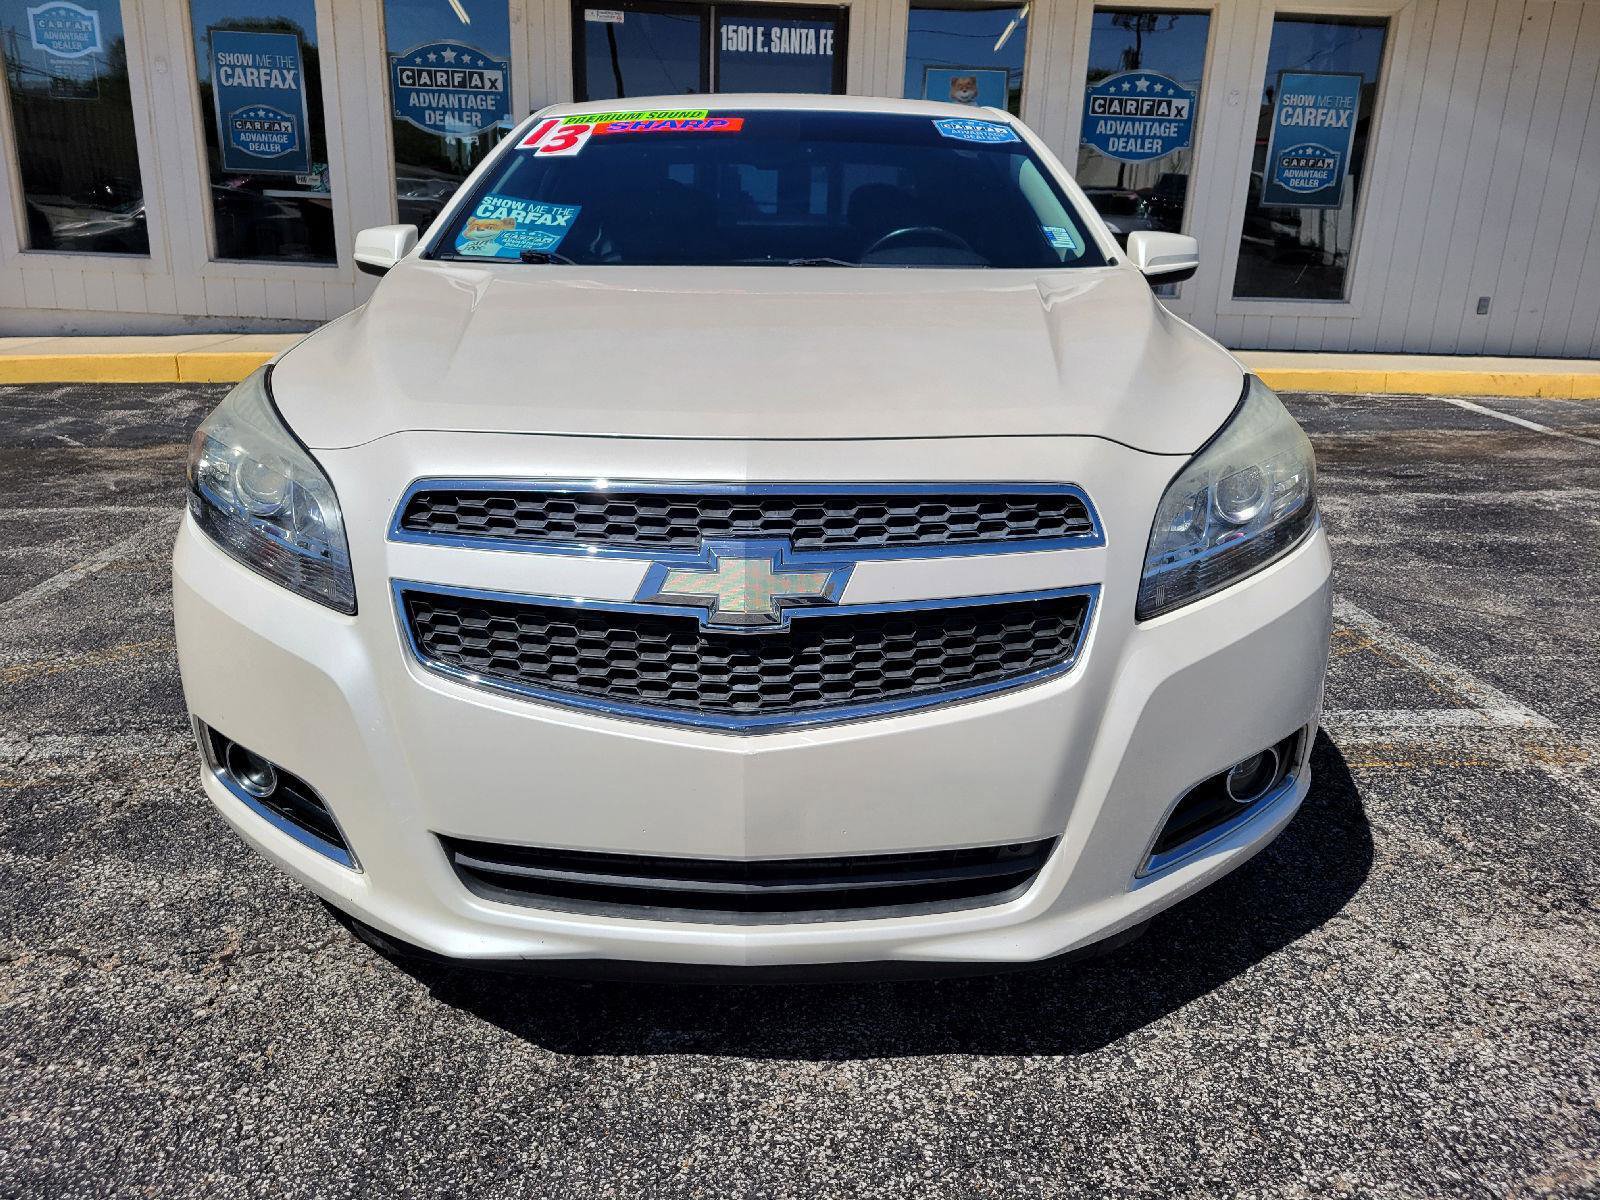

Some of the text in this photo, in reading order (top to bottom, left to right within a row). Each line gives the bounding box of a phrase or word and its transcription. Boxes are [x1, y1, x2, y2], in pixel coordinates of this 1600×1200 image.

[39, 20, 92, 32] CARFAX
[44, 31, 89, 41] ADVANTAGE
[720, 25, 834, 56] 1501 E. SANTA FE
[53, 40, 82, 49] DEALER
[217, 52, 296, 69] SHOW ME THE
[219, 66, 298, 90] CARFAX
[401, 70, 499, 91] CARFAX
[409, 92, 496, 110] ADVANTAGE
[1093, 98, 1186, 118] CARFAX
[1282, 94, 1353, 109] SHOW ME THE
[424, 110, 482, 126] DEALER
[566, 110, 702, 125] PREMIUM SOUND
[607, 118, 730, 132] SHARP
[1280, 107, 1352, 128] CARFAX
[235, 120, 292, 134] CARFAX
[943, 123, 1009, 134] CARFAX
[1096, 120, 1179, 137] ADVANTAGE
[240, 132, 289, 143] ADVANTAGE
[523, 119, 590, 153] 13
[249, 142, 282, 153] DEALER
[1108, 137, 1163, 153] DEALER
[1282, 158, 1334, 169] CARFAX
[1283, 169, 1328, 179] ADVANTAGE
[1289, 178, 1319, 187] DEALER
[481, 196, 575, 216] SHOW ME THE
[476, 204, 573, 227] CARFAX
